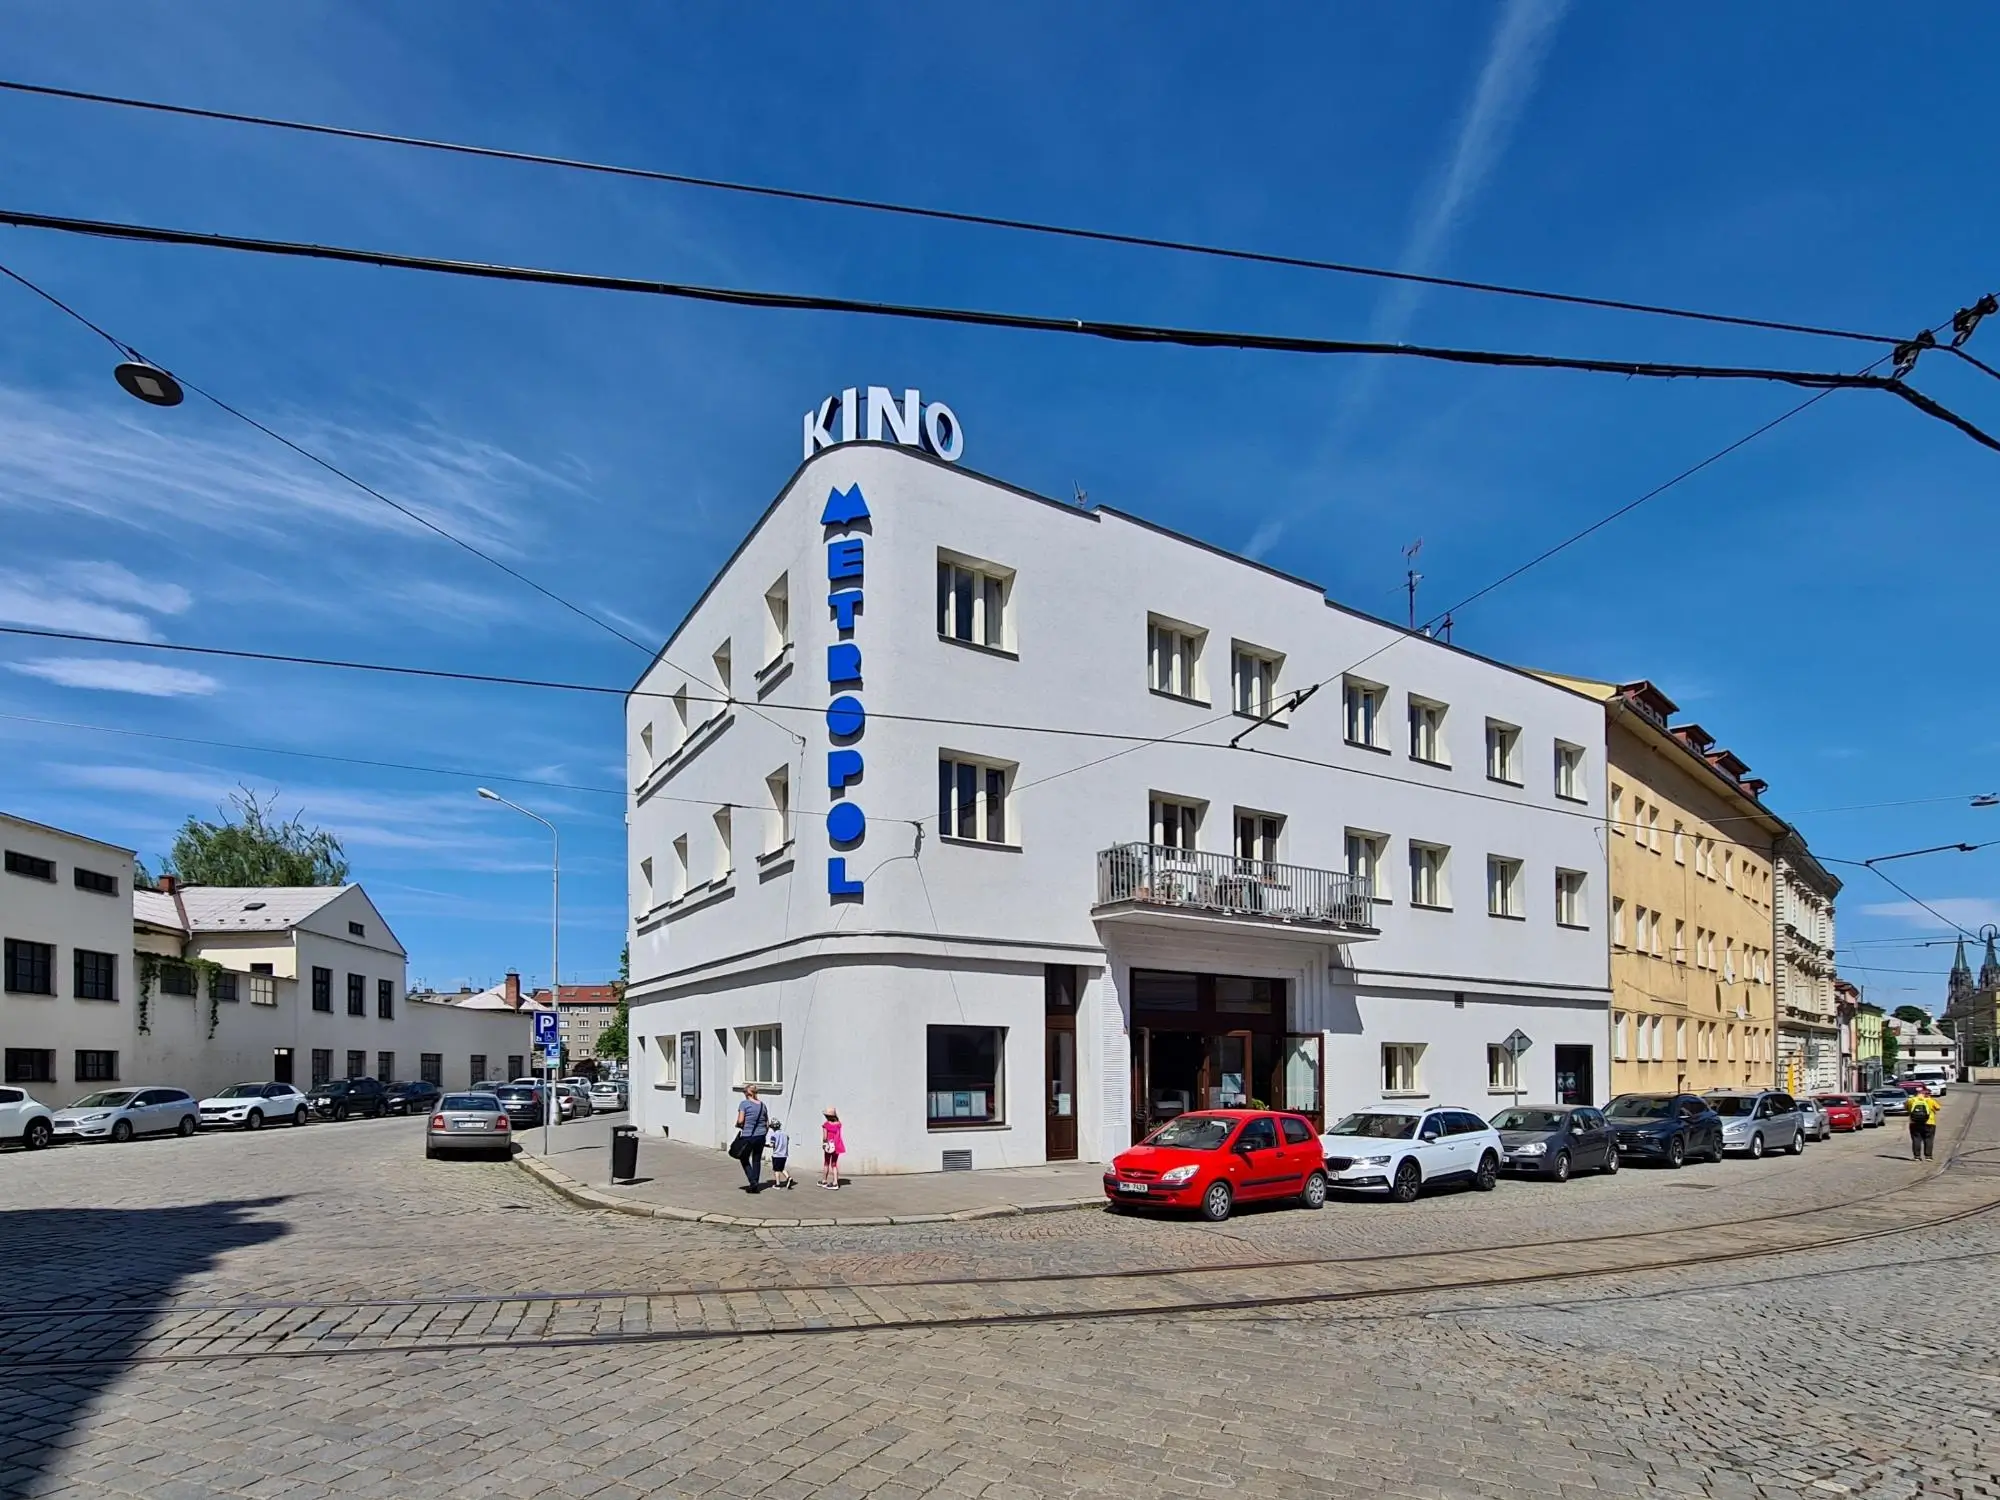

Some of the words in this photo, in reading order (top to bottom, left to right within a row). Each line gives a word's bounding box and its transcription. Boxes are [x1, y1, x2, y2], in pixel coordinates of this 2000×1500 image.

[803, 385, 964, 461] KINO
[821, 482, 871, 896] METROPOL
[540, 1015, 554, 1034] P
